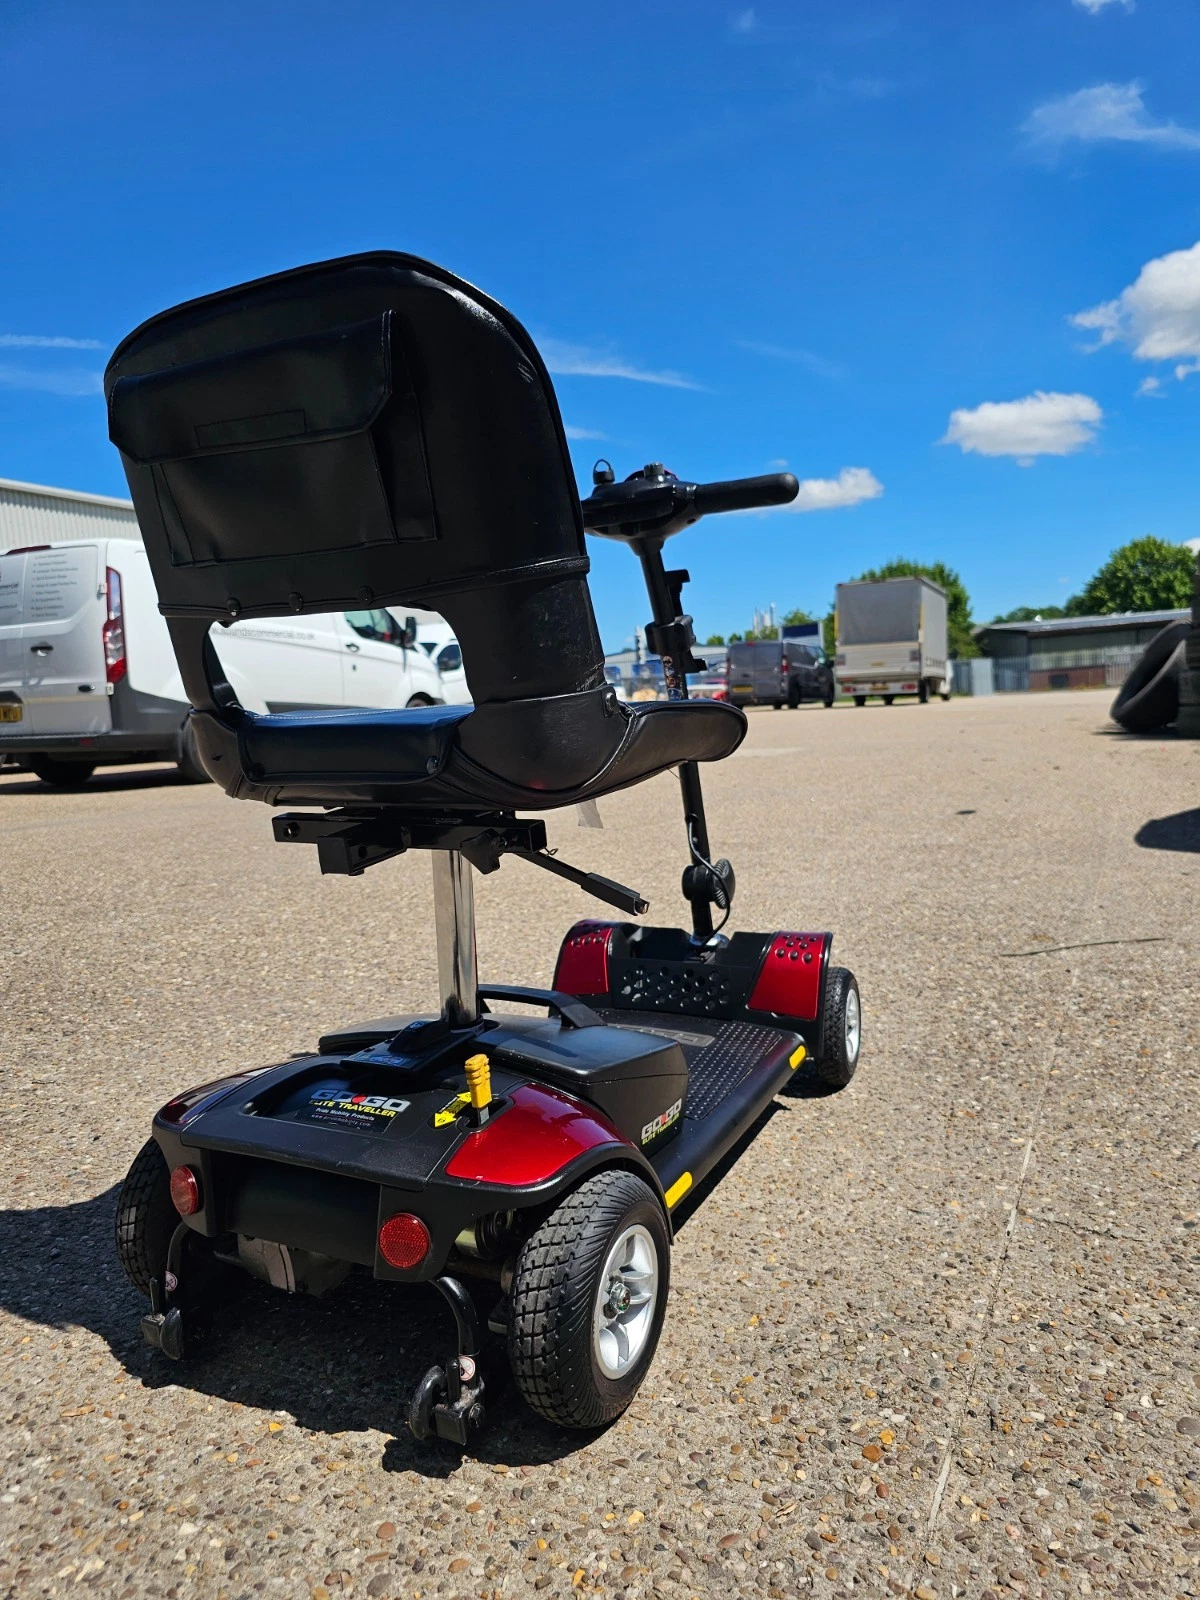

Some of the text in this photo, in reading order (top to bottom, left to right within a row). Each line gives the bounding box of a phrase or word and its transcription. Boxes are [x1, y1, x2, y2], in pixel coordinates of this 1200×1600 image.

[309, 1099, 397, 1118] ELITE TRAVELLER
[315, 1107, 375, 1121] Pride Mobility Products
